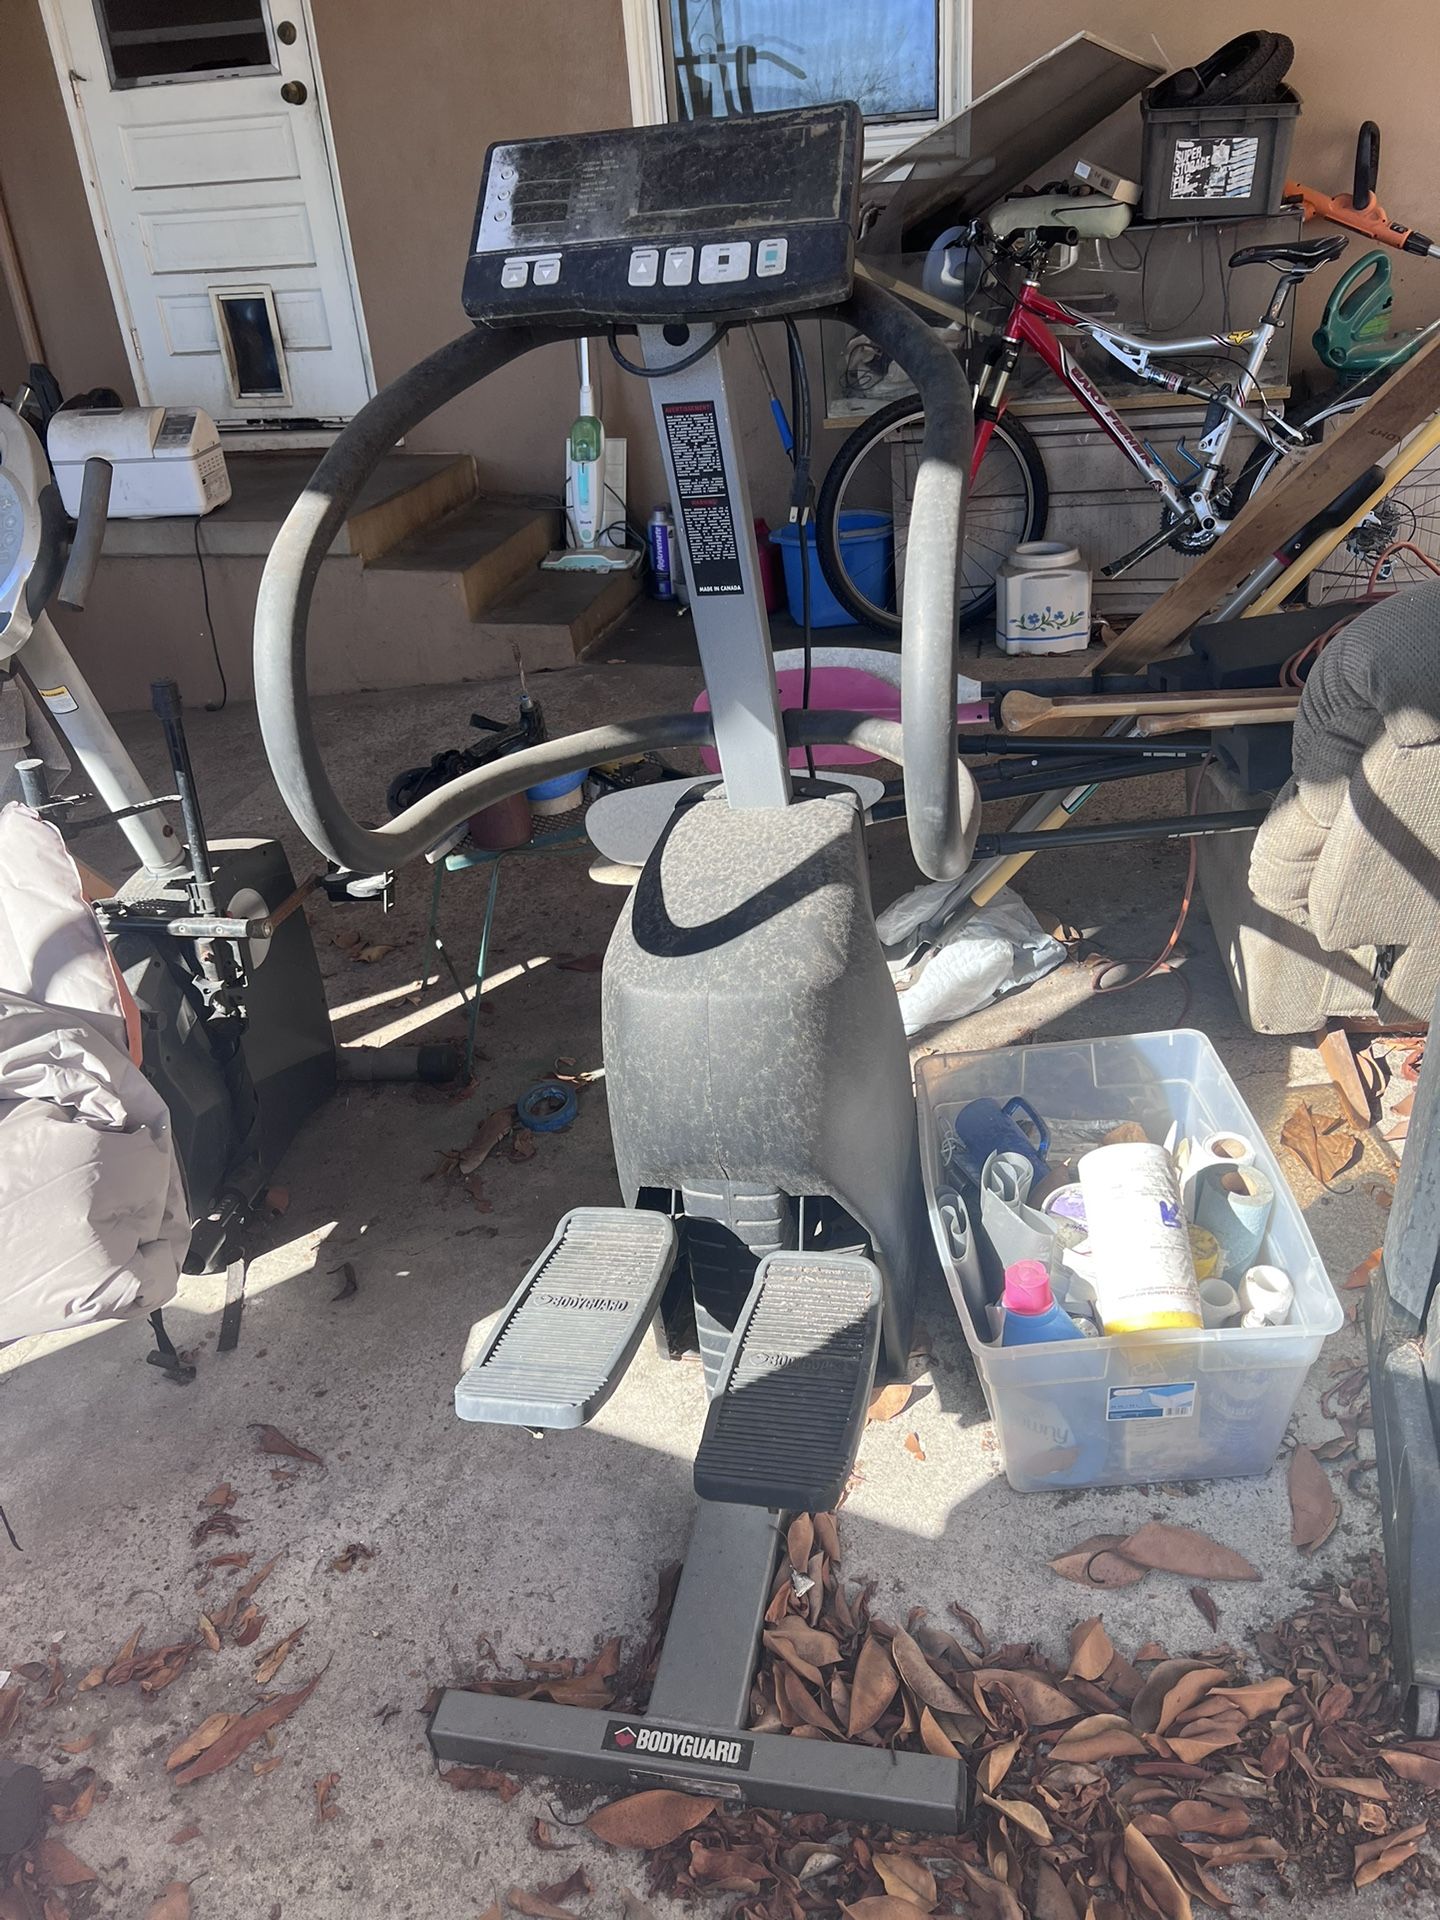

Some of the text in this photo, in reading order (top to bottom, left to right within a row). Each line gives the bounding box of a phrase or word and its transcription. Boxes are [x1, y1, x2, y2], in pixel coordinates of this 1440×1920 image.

[1174, 156, 1211, 176] STORAGE
[1176, 146, 1202, 163] SUPER
[1071, 366, 1154, 468] GARY FISHER
[655, 526, 666, 571] Rejuvenate
[636, 1729, 742, 1764] BODYGUARD
